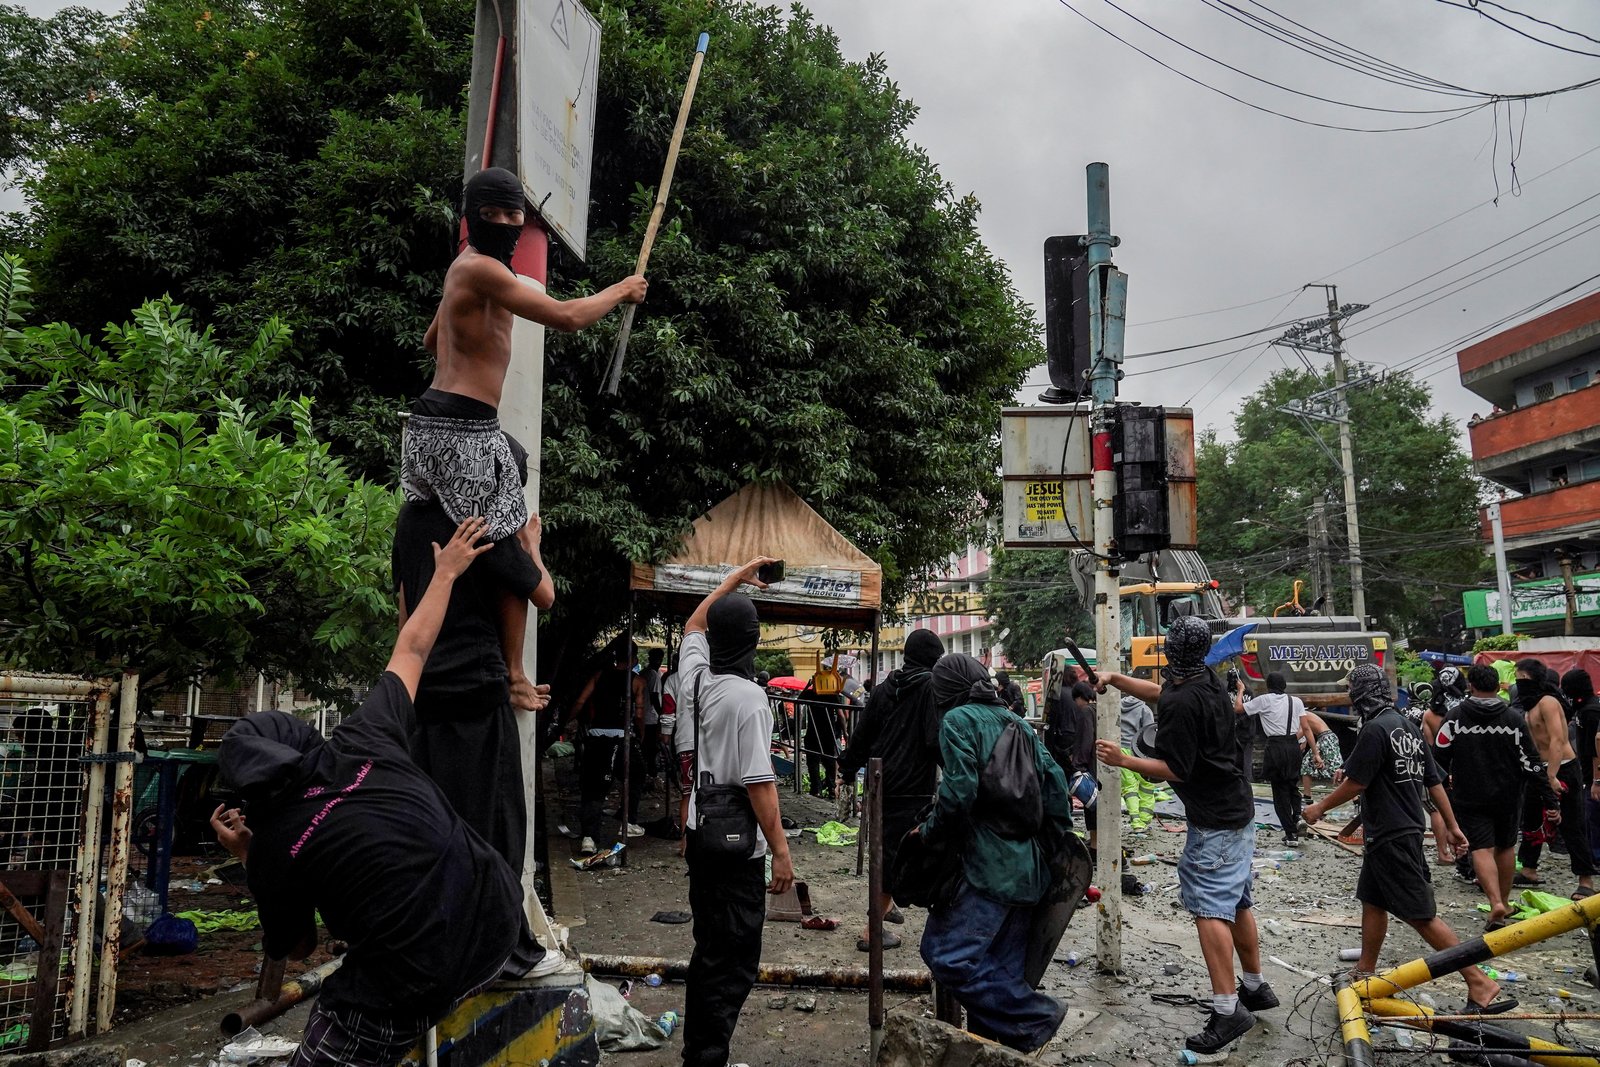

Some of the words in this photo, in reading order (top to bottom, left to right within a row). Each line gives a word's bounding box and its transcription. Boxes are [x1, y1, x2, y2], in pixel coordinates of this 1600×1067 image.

[1026, 483, 1062, 495] JESUS
[806, 589, 846, 598] Linoleum
[1268, 645, 1368, 660] METALITE
[1286, 659, 1355, 672] VOLVO
[289, 826, 314, 858] Always
